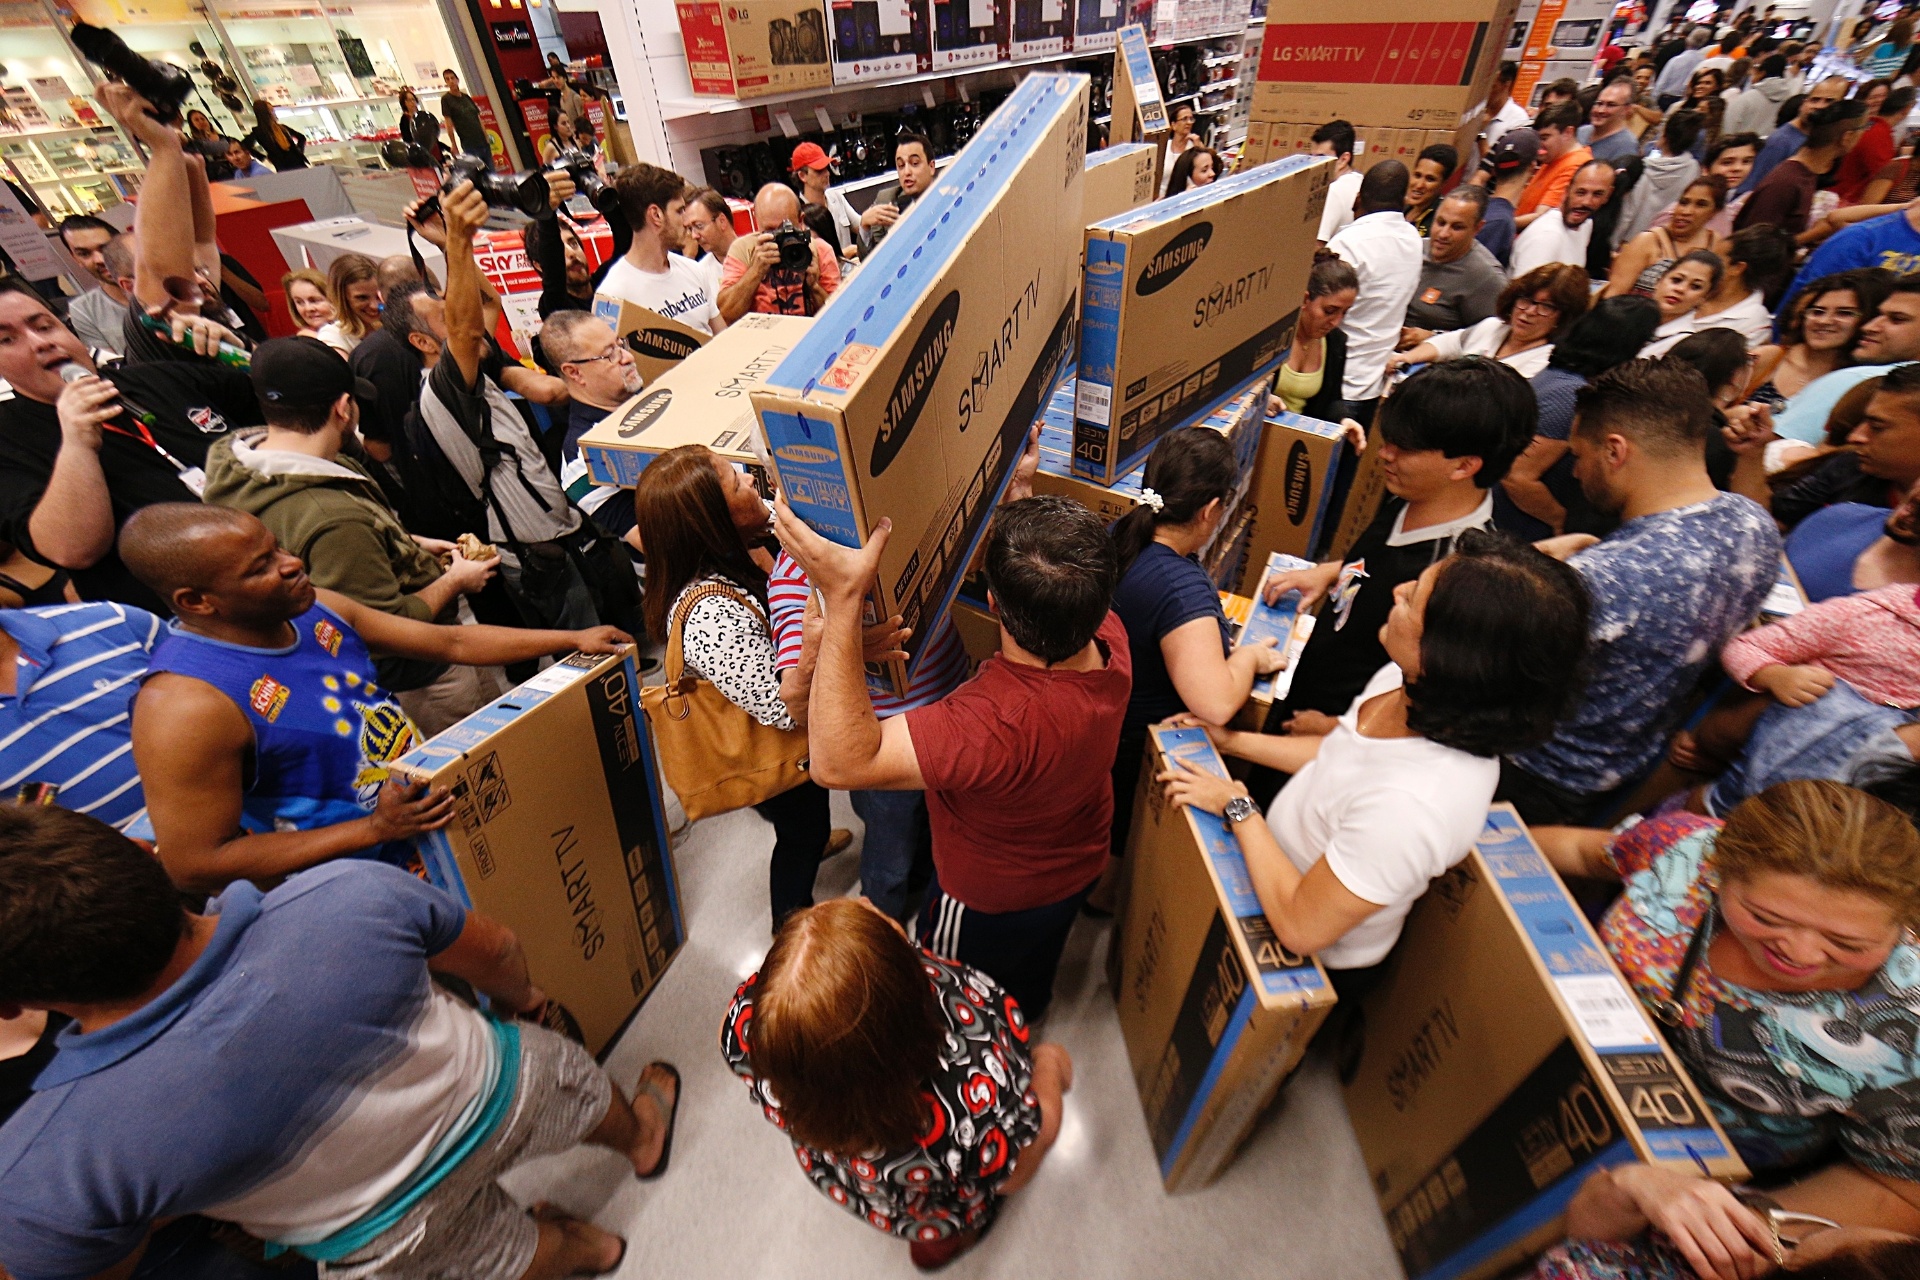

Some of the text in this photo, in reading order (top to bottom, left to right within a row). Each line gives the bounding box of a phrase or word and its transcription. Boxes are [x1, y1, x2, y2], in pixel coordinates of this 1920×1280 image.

[738, 10, 749, 19] LG
[1273, 45, 1365, 62] LG SMART TV
[479, 255, 512, 271] SKY
[1147, 238, 1204, 280] SAMSUNG
[649, 288, 706, 320] mberland
[1193, 263, 1275, 328] SMART TV
[637, 330, 693, 357] SAMSUNG
[959, 268, 1041, 433] SMART TV
[715, 345, 788, 398] SMART TV
[881, 318, 952, 443] SAMSUNG
[619, 393, 673, 432] SAMSUNG
[783, 447, 832, 463] SAMSUNG
[1286, 452, 1309, 516] SAMSUNG
[842, 528, 856, 539] TV
[896, 558, 918, 598] NETFLIX
[319, 623, 335, 648] SCHIN
[255, 679, 278, 712] SCHIN
[474, 837, 492, 877] FRONT
[551, 825, 606, 962] SMART TV
